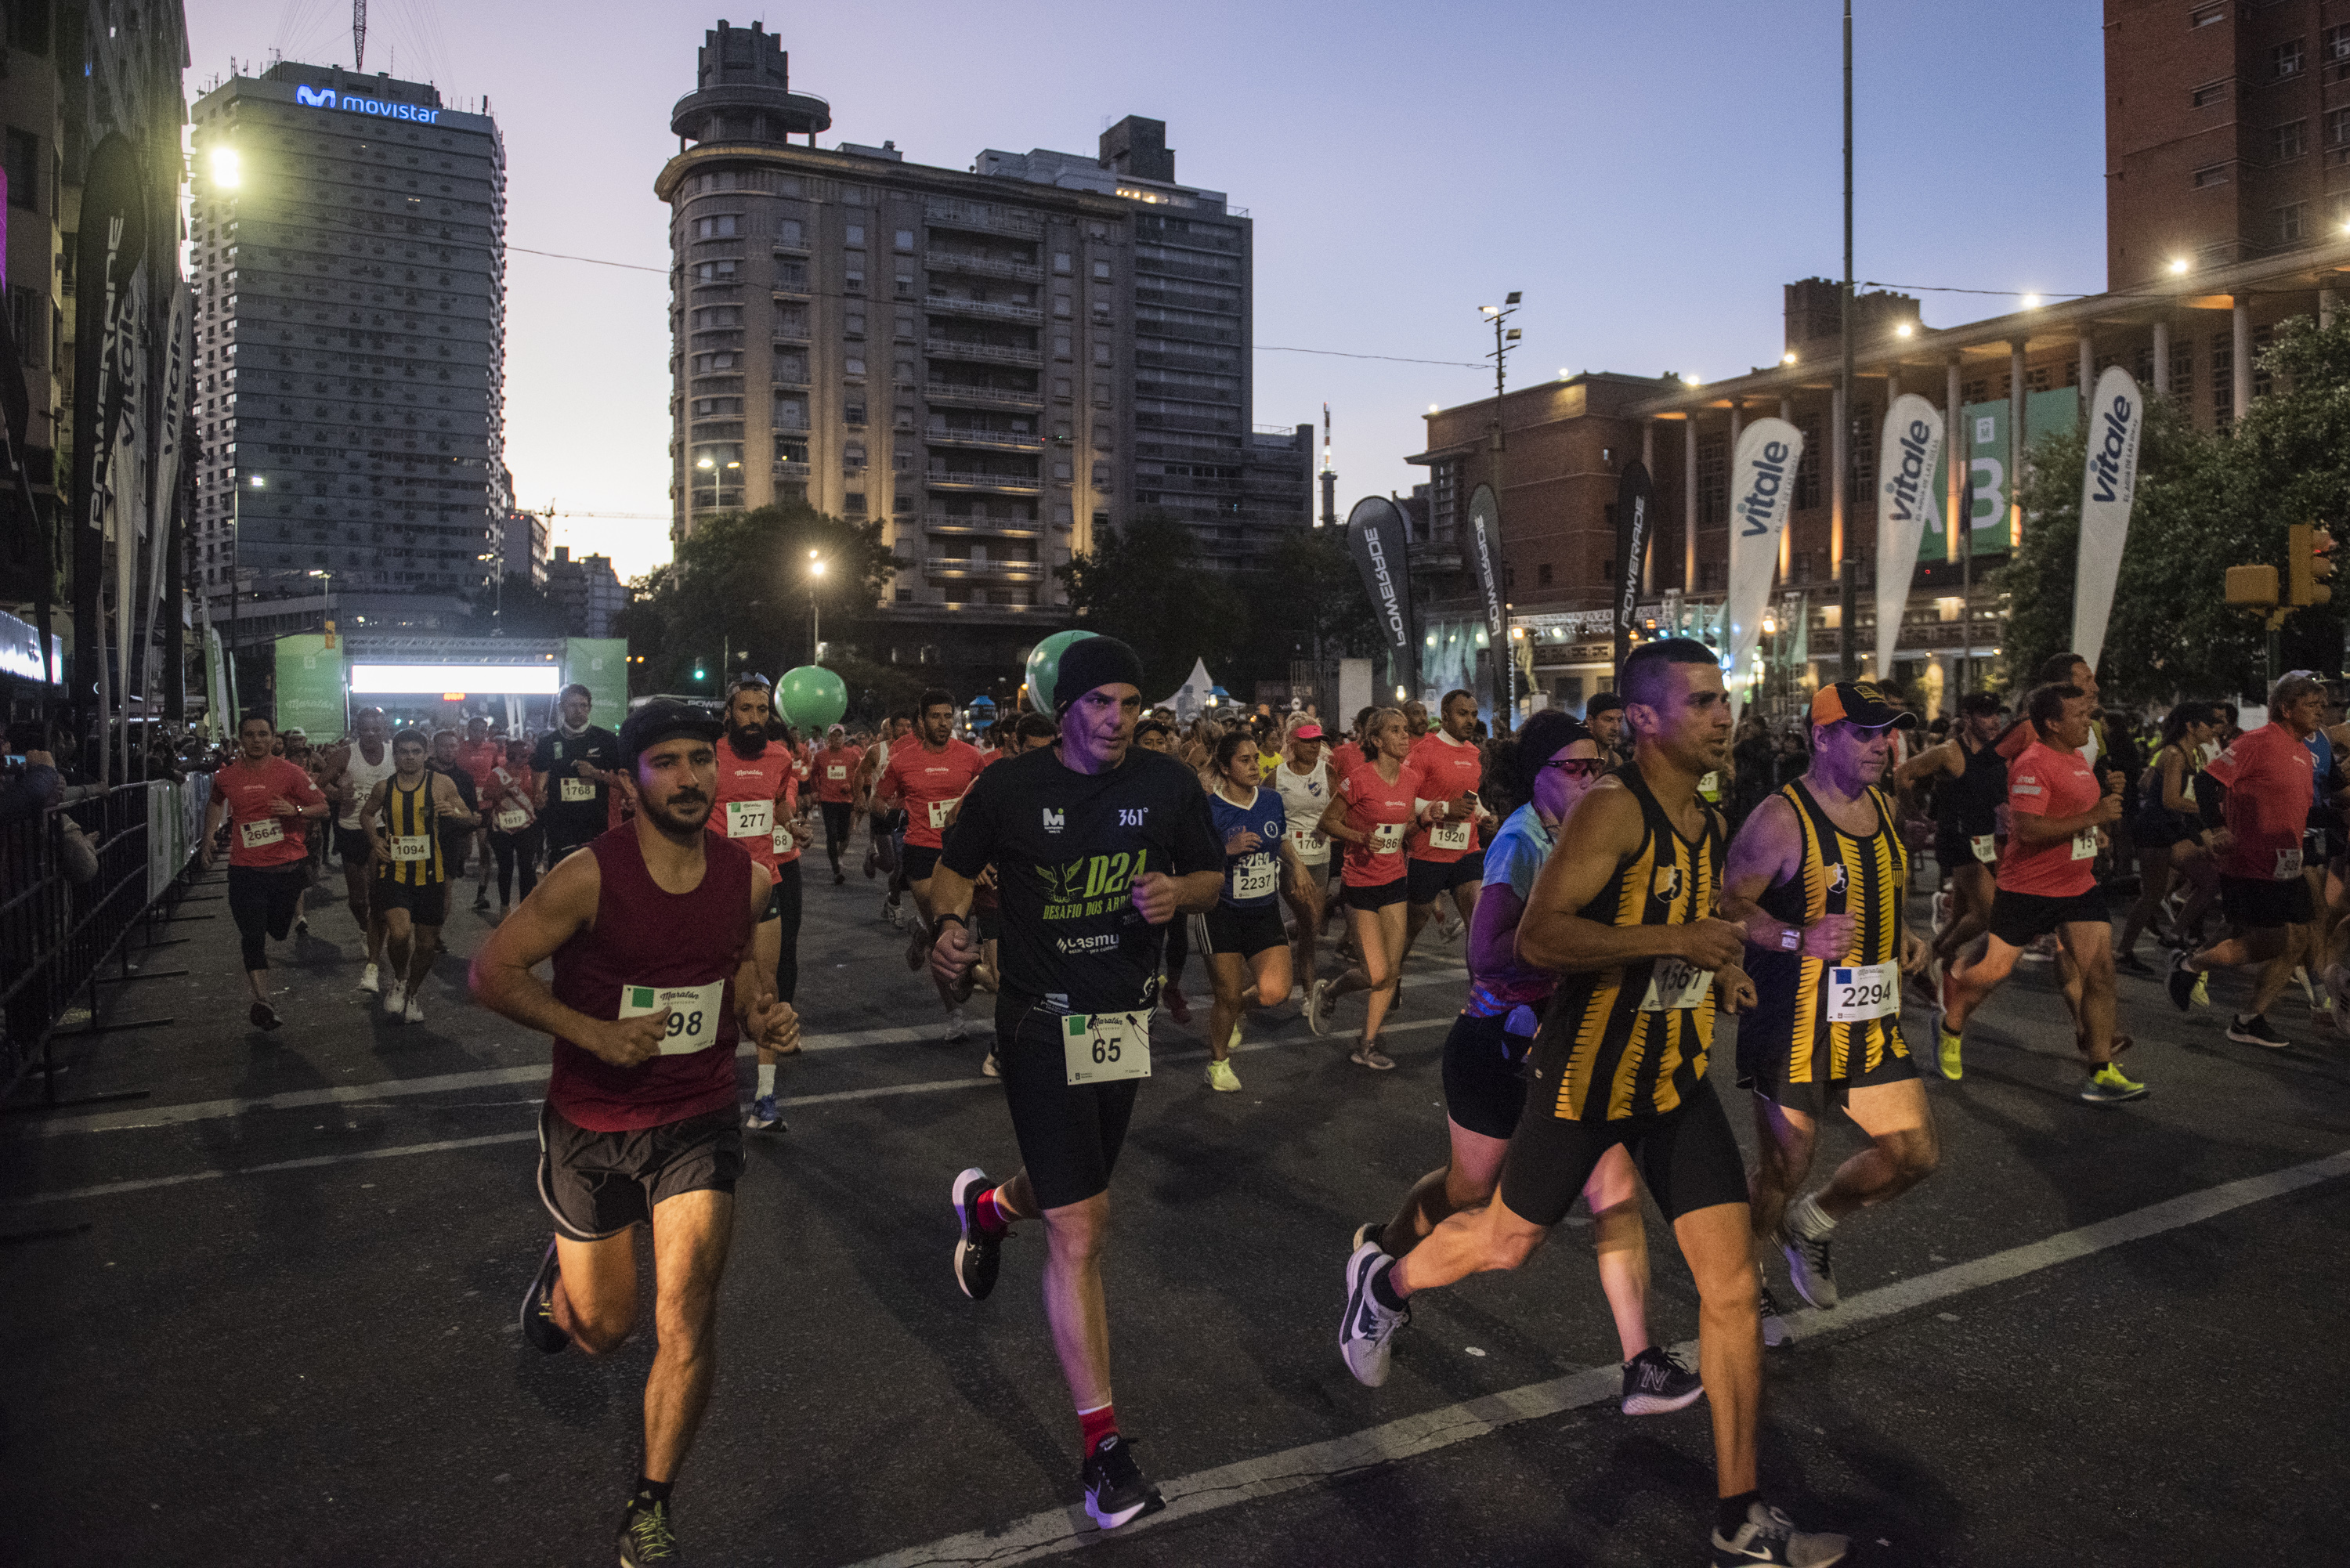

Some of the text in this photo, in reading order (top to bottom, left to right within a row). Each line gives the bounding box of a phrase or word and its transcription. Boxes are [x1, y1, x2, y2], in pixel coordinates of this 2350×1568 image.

[342, 96, 439, 124] movistar
[163, 311, 182, 455] vitale
[2089, 395, 2131, 502] vitale
[1885, 419, 1931, 521] vitale
[1737, 441, 1789, 537] vitale
[1621, 496, 1645, 628] POWERADE
[566, 787, 591, 796] 1768
[740, 814, 765, 828] 277
[248, 827, 277, 841] 2664
[774, 835, 787, 846] 68
[1438, 831, 1465, 842] 1920
[396, 846, 425, 855] 1094
[1240, 874, 1271, 891] 2237
[1043, 903, 1083, 919] DESAFIO
[1086, 900, 1104, 916] DOS
[660, 991, 700, 1001] Maratón
[1842, 980, 1891, 1007] 2294
[666, 1010, 703, 1037] 98
[1092, 1037, 1122, 1064] 65
